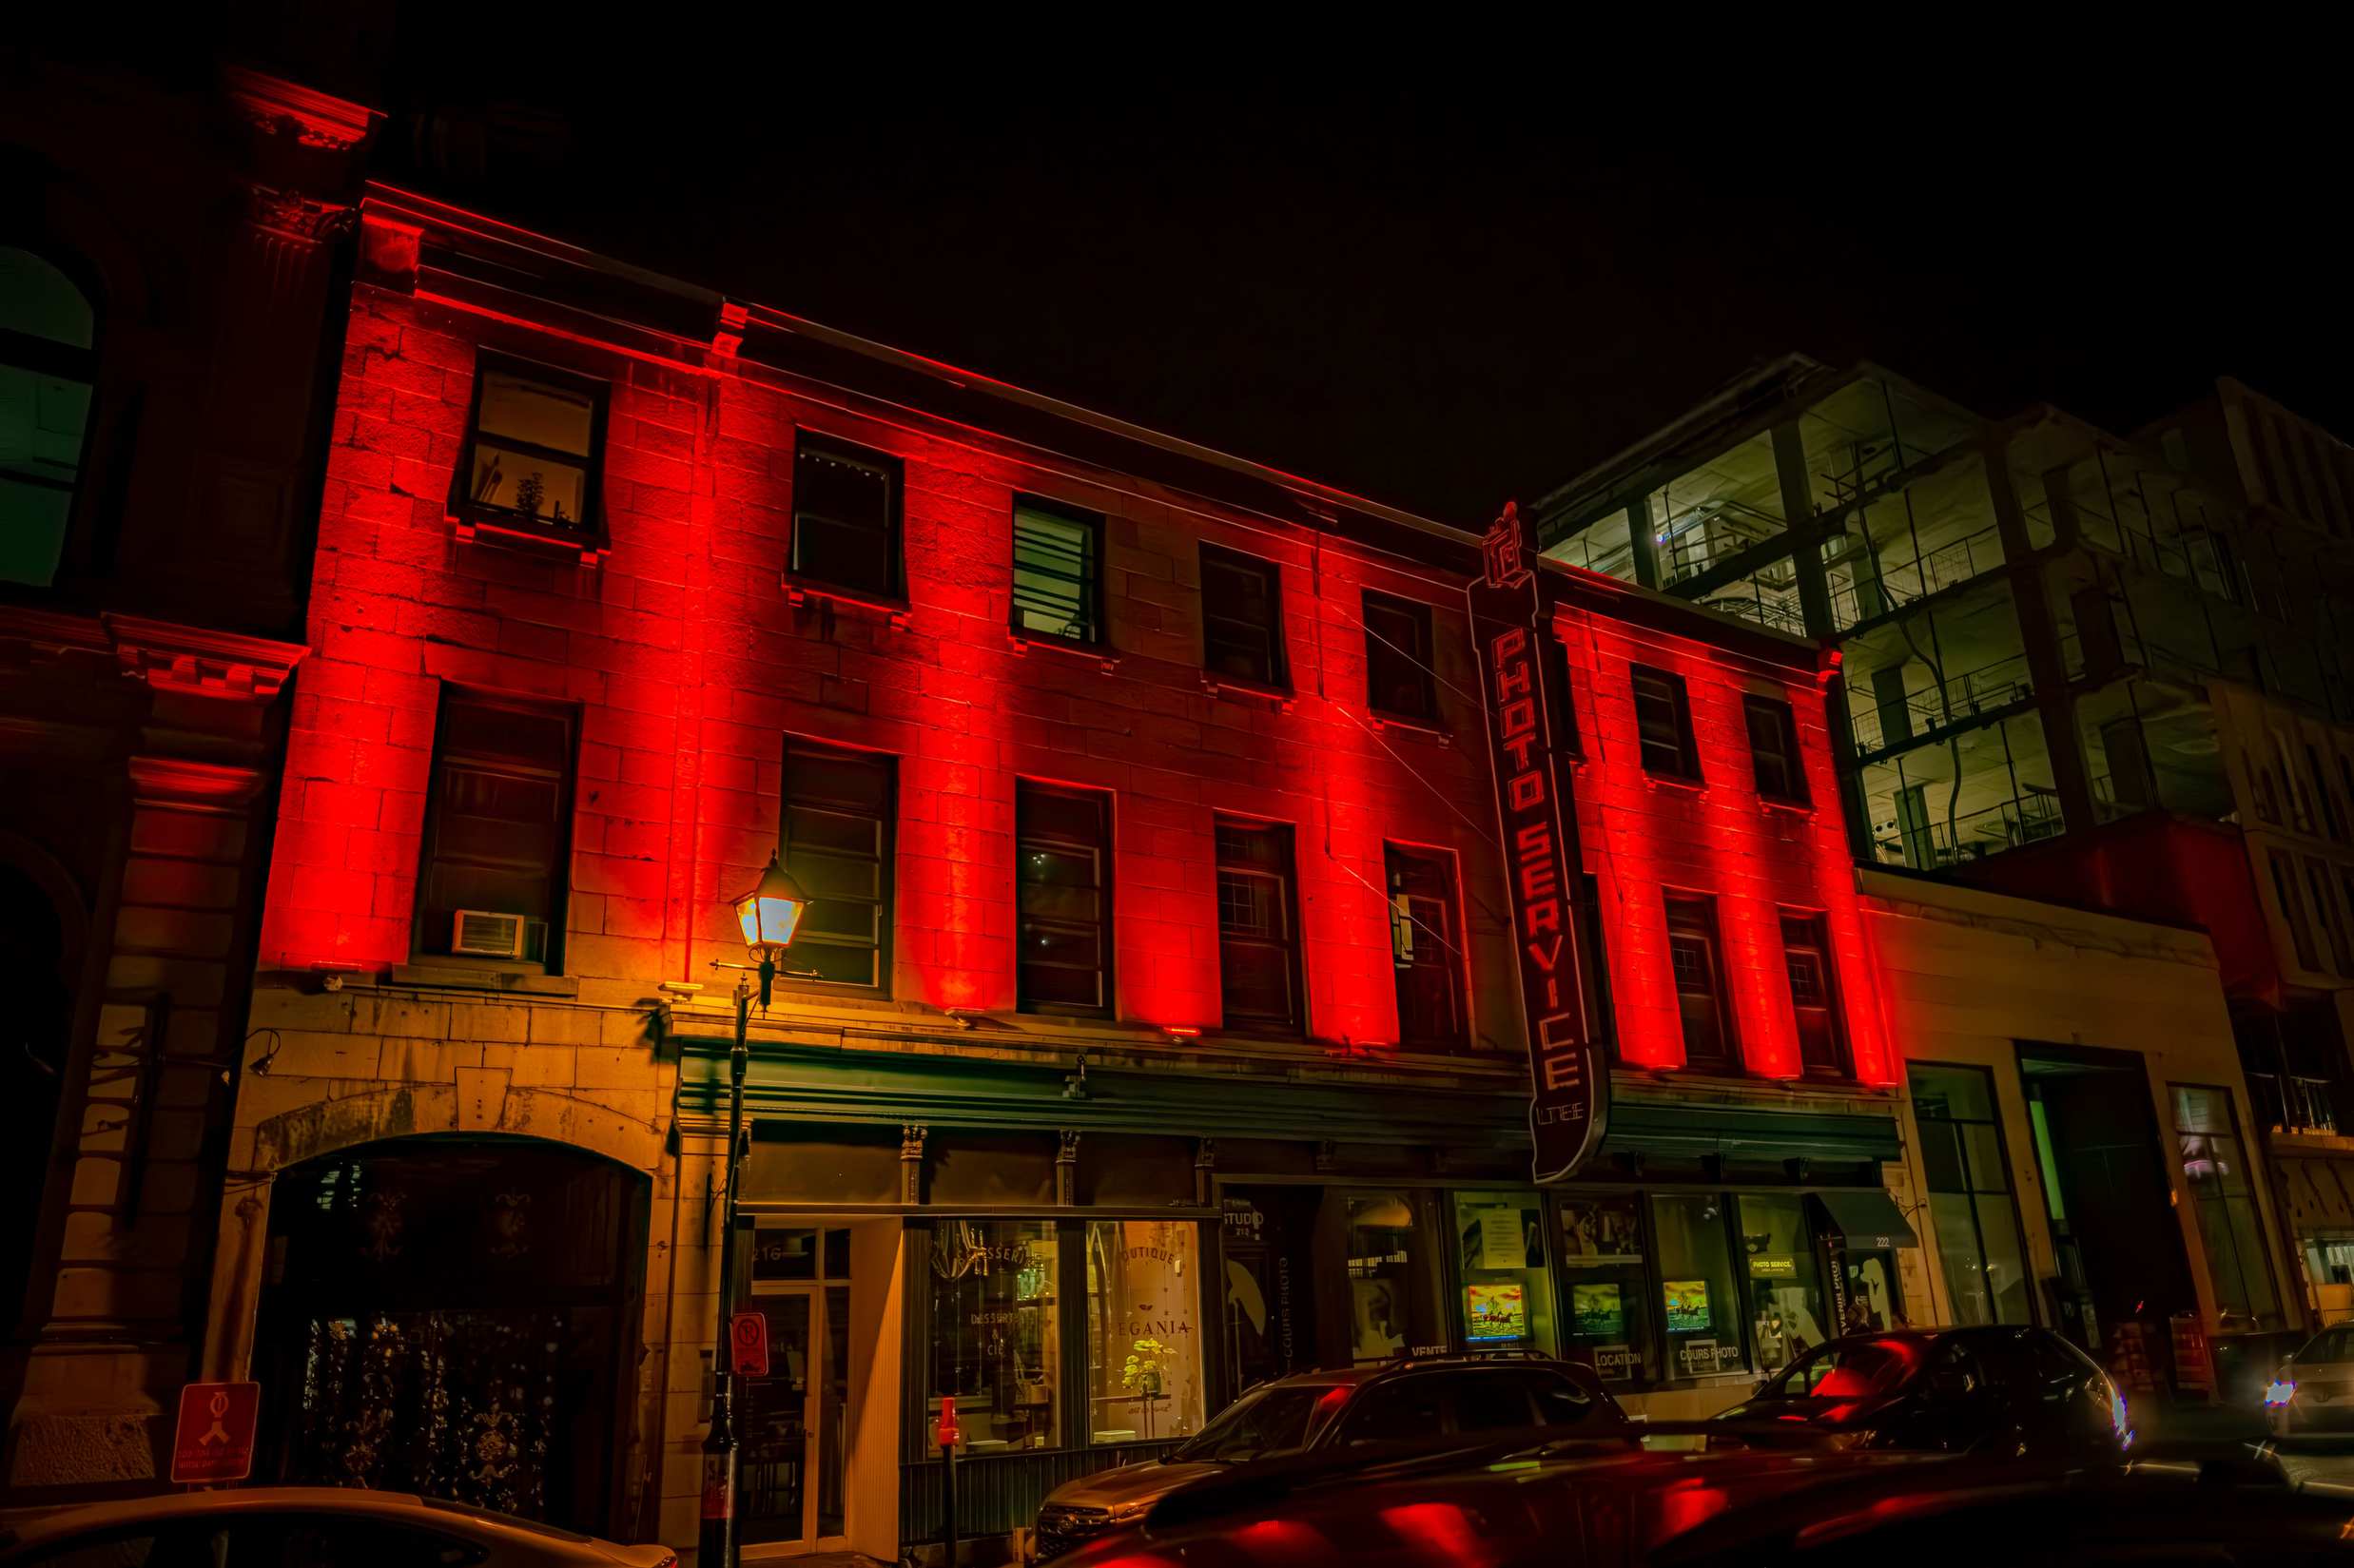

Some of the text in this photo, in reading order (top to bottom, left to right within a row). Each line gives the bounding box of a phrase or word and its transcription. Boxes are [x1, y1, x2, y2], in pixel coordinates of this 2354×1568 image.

[1491, 627, 1581, 1091] PHOTO SERVICE
[1877, 1236, 1891, 1248] 222
[1118, 1321, 1189, 1336] EGANIA
[1411, 1345, 1448, 1357] VENTE
[1679, 1345, 1740, 1361] COURS PHOTO
[1596, 1352, 1643, 1366] LOCATION
